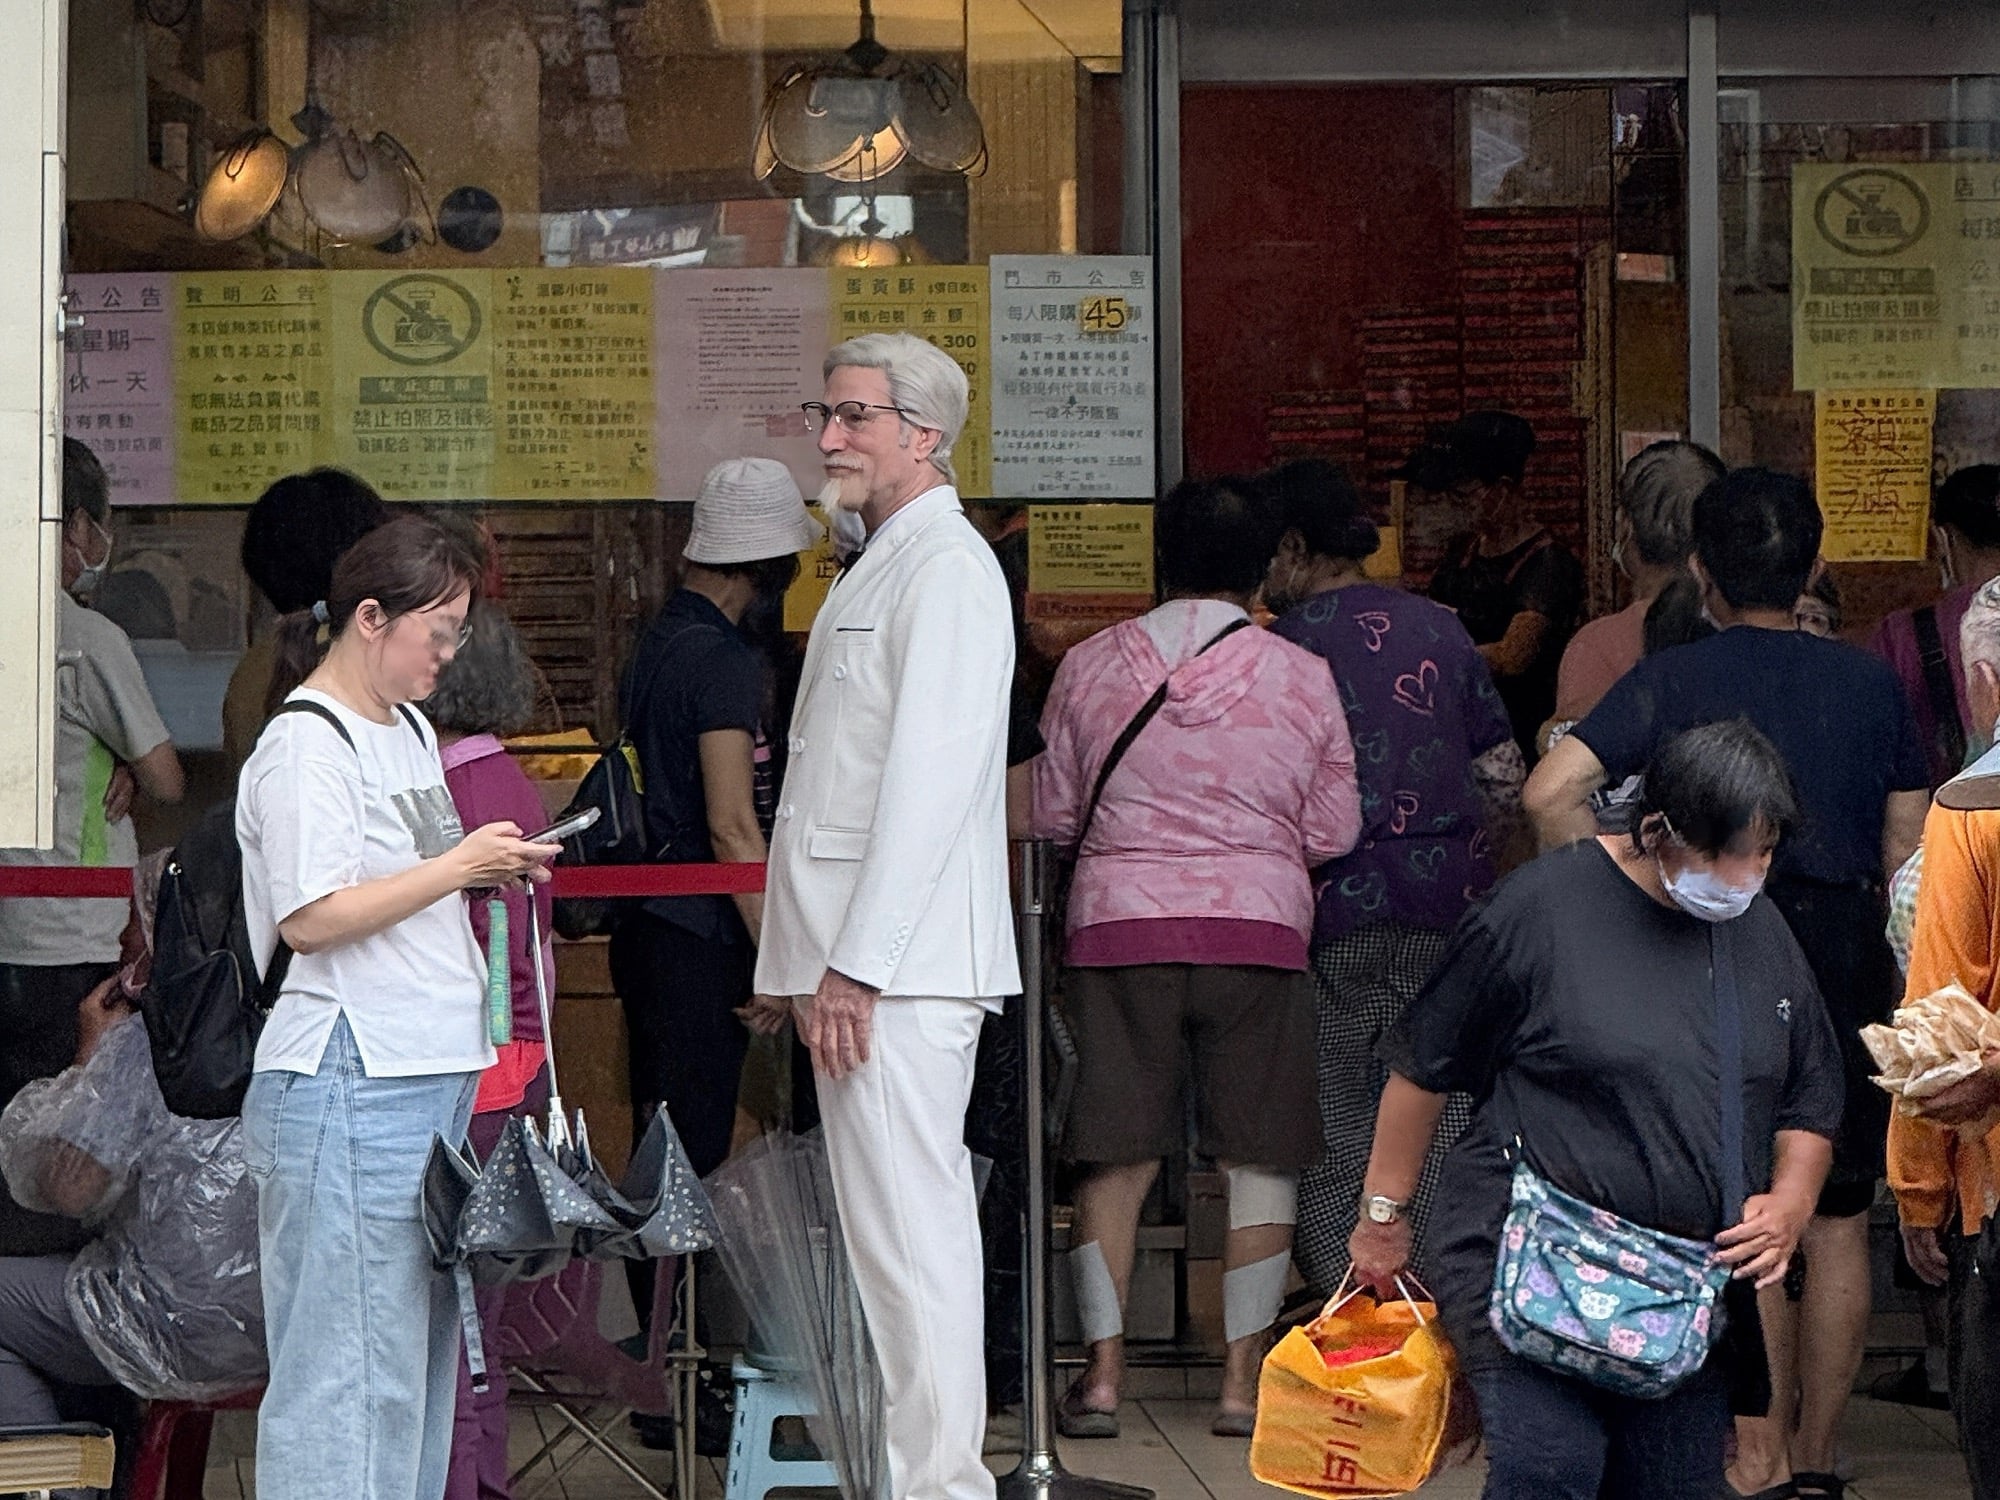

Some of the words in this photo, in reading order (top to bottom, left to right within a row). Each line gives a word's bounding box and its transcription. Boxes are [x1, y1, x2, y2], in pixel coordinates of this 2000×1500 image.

[846, 277, 917, 295] 蛋黃酥
[1004, 270, 1146, 285] 門市公告
[186, 285, 315, 303] 聲明公告
[922, 308, 964, 323] 金額
[1007, 304, 1077, 321] 每人限購
[1085, 297, 1126, 329] 45
[66, 328, 155, 351] 星期一
[943, 334, 977, 348] 300
[353, 408, 493, 428] 禁止拍照及攝影
[1030, 405, 1120, 420] 一律不予販售
[190, 415, 321, 434] 商品之品質問題
